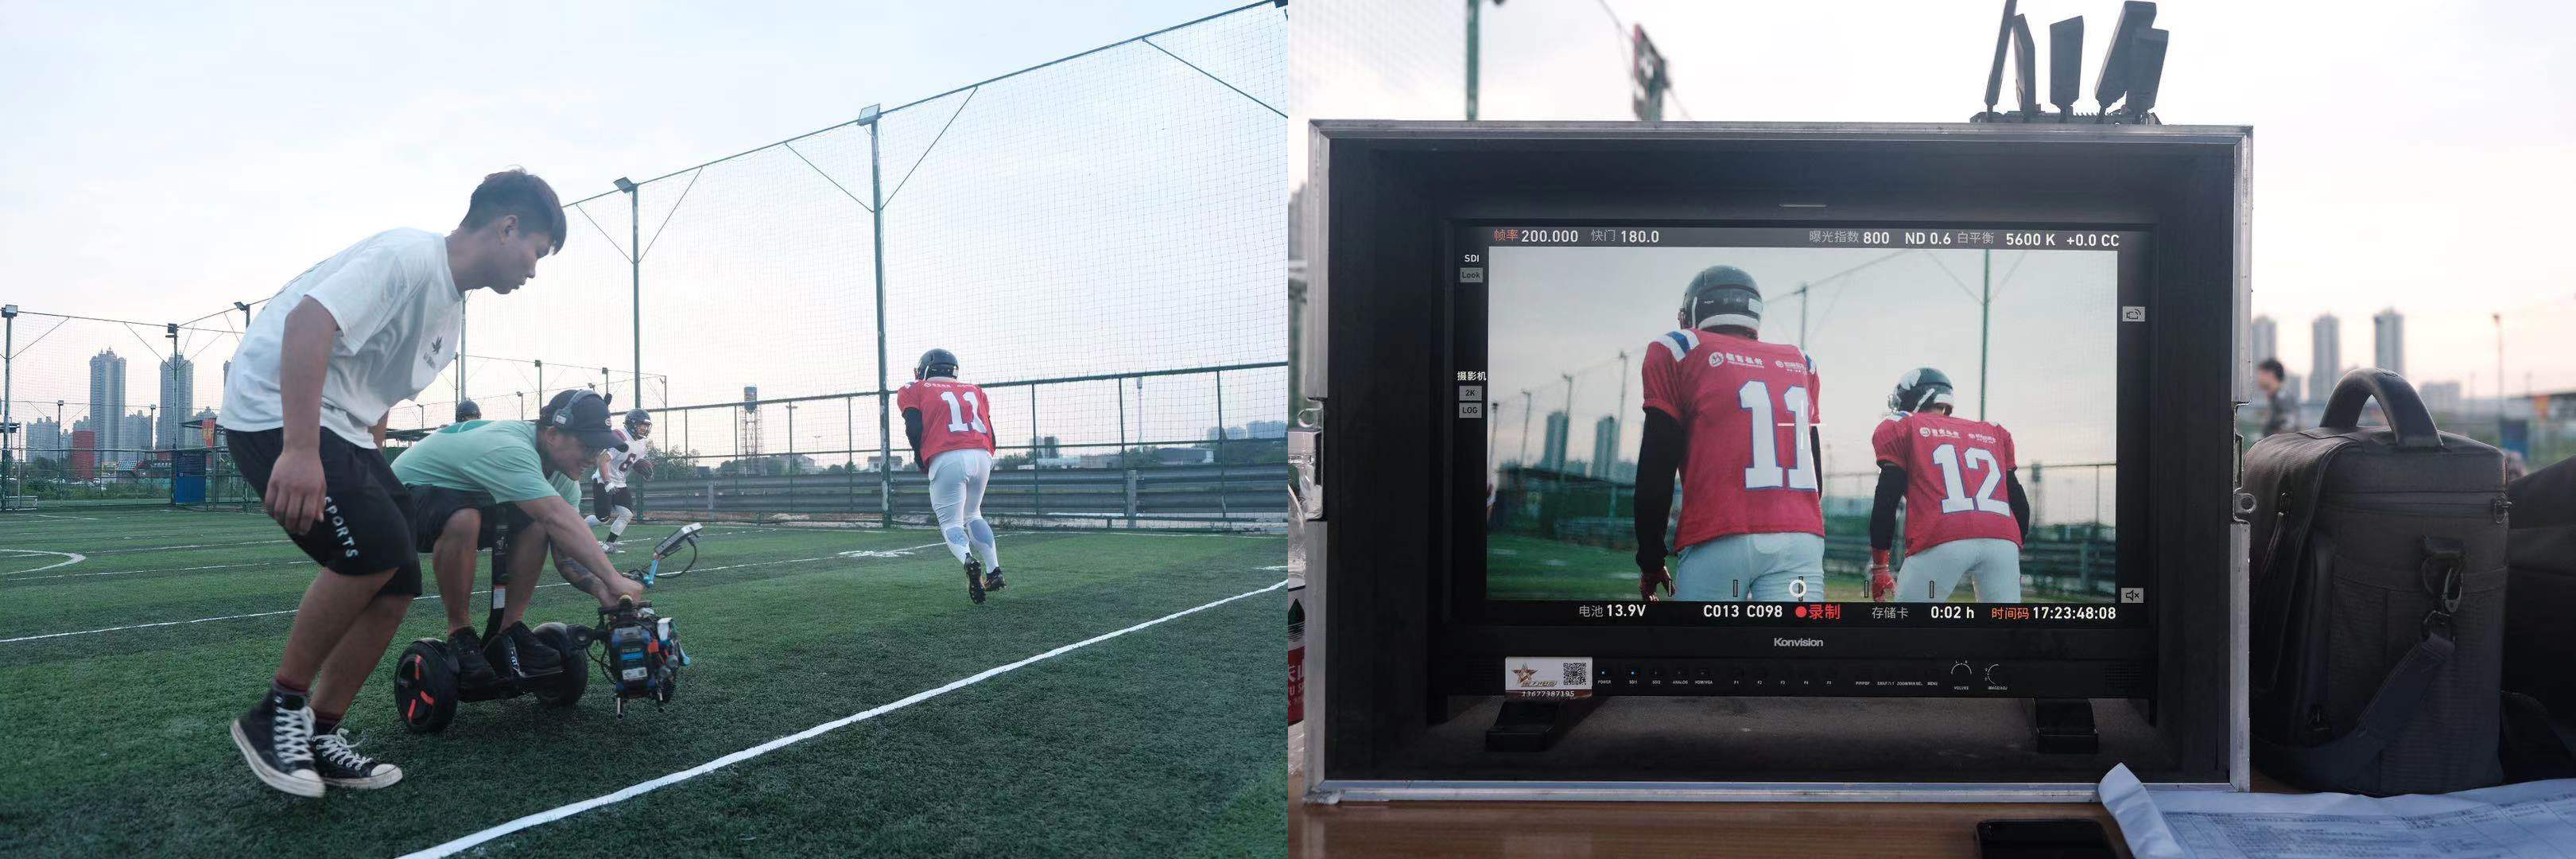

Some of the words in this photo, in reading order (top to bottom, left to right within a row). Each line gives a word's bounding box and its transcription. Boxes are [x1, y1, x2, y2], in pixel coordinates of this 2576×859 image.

[1494, 228, 1519, 241] 帧率
[1521, 229, 1578, 243] 200.000
[1590, 229, 1616, 242] 快门
[1621, 230, 1659, 243] 180.0
[1809, 230, 1859, 243] 曝光指数
[1863, 231, 1890, 244] 800
[1905, 231, 1926, 245] ND
[1930, 232, 1951, 245] 0.6
[1957, 231, 1994, 244] 白平衡
[2006, 233, 2041, 246] 5600
[2046, 233, 2056, 246] K
[2066, 234, 2097, 247] +0.0
[2101, 234, 2120, 247] CC
[1465, 254, 1480, 262] SDI
[1457, 371, 1487, 381] 摄影机
[940, 391, 988, 435] 11
[1738, 379, 1818, 493] 11
[1932, 443, 2012, 518] 12
[1579, 604, 1604, 617] 电池
[1607, 604, 1647, 616] 13.9V
[1703, 604, 1740, 617] C013
[1747, 604, 1783, 618] C098
[1809, 604, 1840, 620] 录制
[1872, 606, 1909, 619] 存储卡
[1930, 605, 1961, 619] 0:02
[1966, 606, 1975, 619] h
[1992, 607, 2030, 620] 时间码
[2033, 606, 2116, 620] 17:23:48:08
[1774, 637, 1824, 647] Konvision
